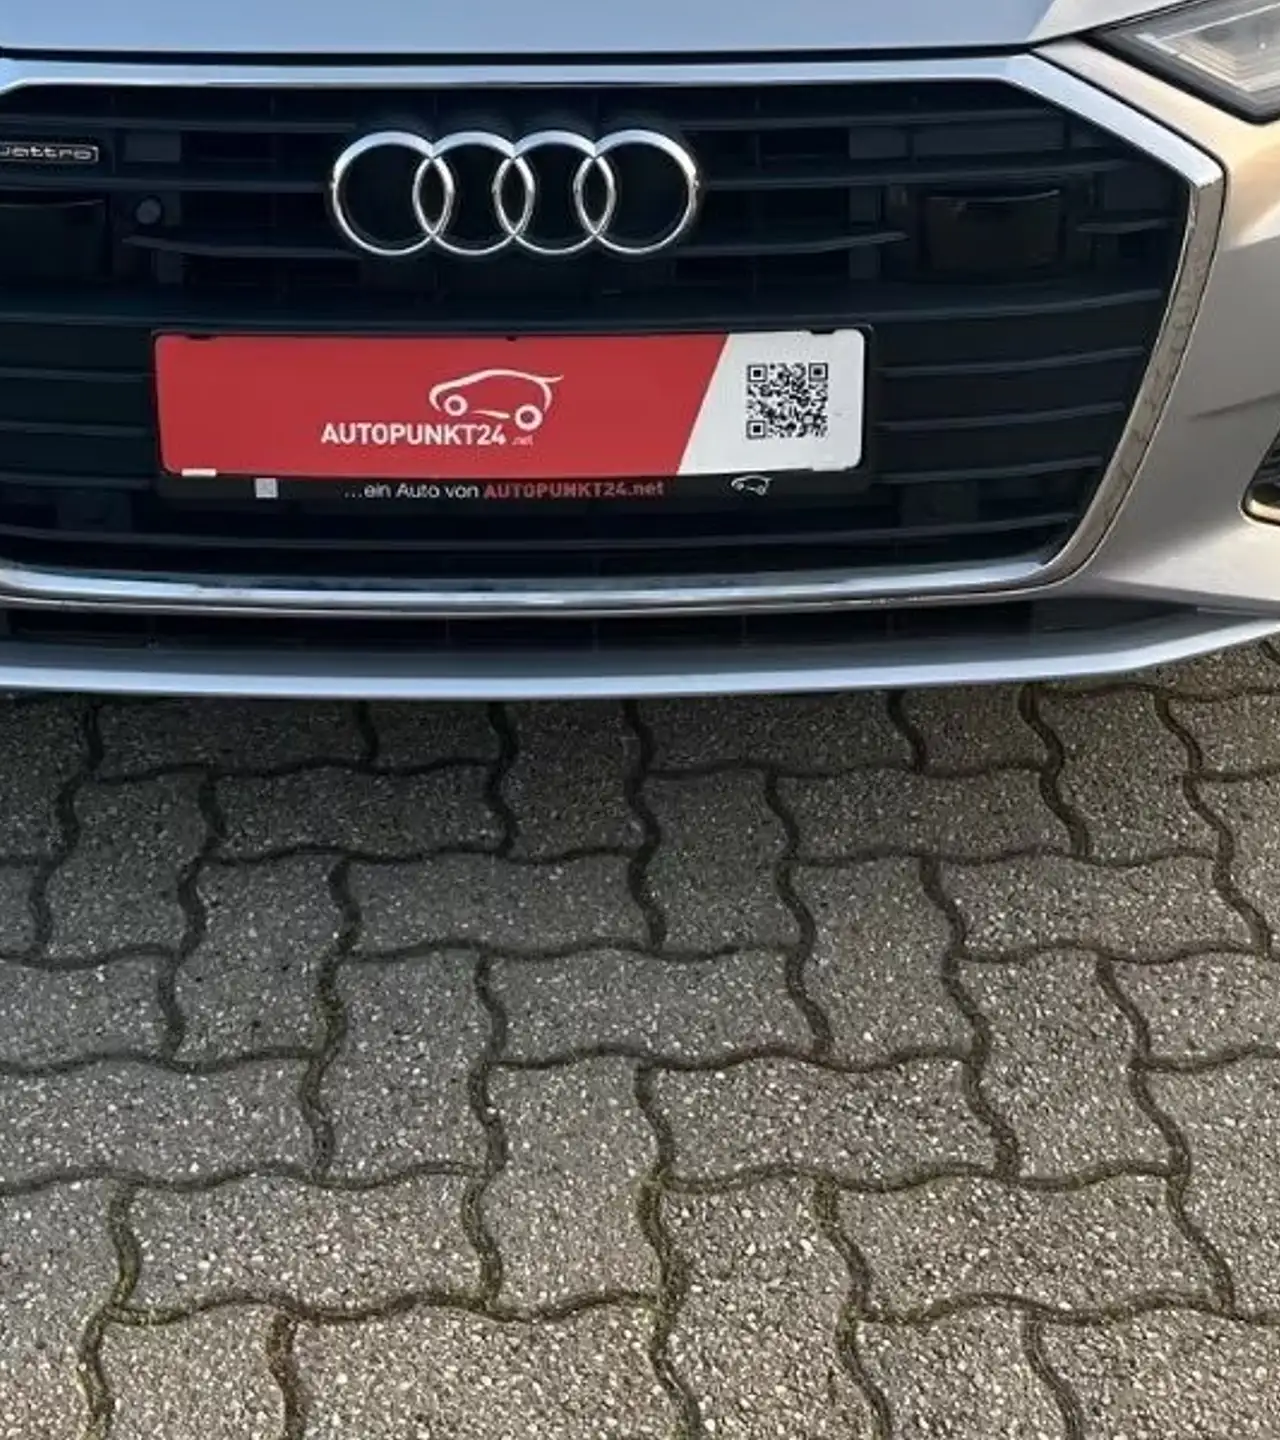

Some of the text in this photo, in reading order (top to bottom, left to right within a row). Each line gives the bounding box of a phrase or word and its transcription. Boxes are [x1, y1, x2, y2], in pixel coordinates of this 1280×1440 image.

[321, 423, 506, 446] AUTOPUNKT24
[396, 482, 440, 498] Auto
[445, 485, 480, 499] von
[484, 481, 663, 498] AUTOPUNKT24.net
